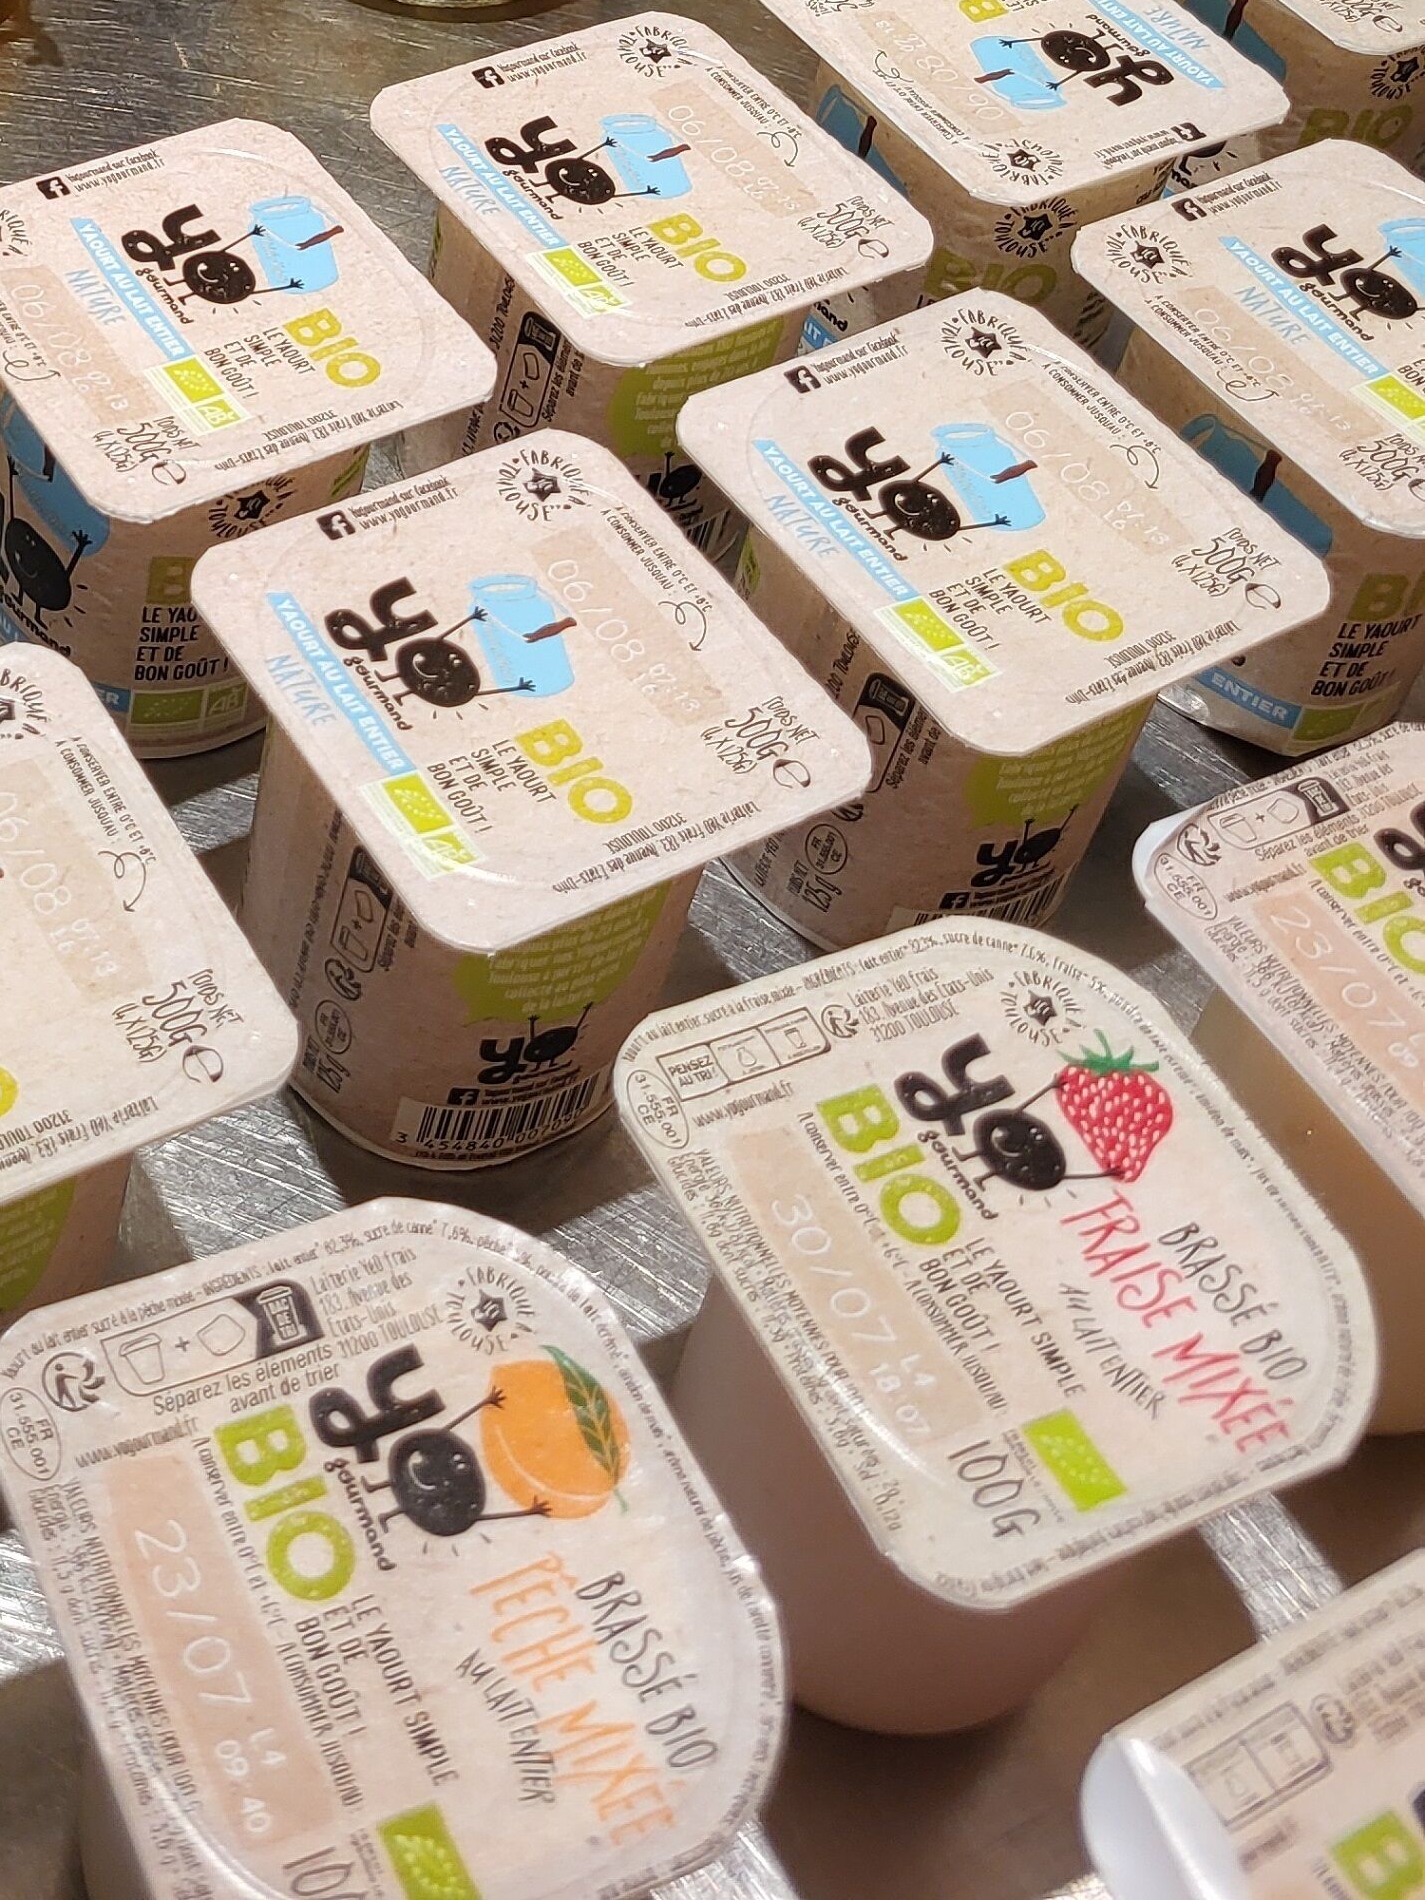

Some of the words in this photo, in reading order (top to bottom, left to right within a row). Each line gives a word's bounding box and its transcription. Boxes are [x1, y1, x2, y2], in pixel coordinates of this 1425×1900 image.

[644, 213, 743, 285] BIO
[134, 266, 195, 325] gourmand
[1298, 281, 1375, 342] gourmand
[281, 307, 380, 390] BIO
[760, 447, 816, 499] YAOURT
[807, 499, 835, 519] AU
[826, 518, 863, 549] LAIT
[854, 548, 908, 598] ENTIER
[831, 494, 909, 562] gourmand
[1002, 547, 1122, 643] BIO
[139, 625, 200, 642] SIMPLE
[1329, 641, 1389, 658] SIMPLE
[135, 665, 168, 680] BON
[273, 600, 327, 659] YAOURT
[314, 659, 343, 682] AU
[331, 681, 368, 716] LAIT
[356, 715, 407, 771] ENTIER
[342, 654, 415, 731] gourmand
[1211, 672, 1289, 720] ENTIER
[515, 715, 633, 823] BIO
[663, 1054, 715, 1078] PENSEZ
[814, 1081, 960, 1246] BIO
[916, 1130, 998, 1222] gourmand
[918, 1257, 958, 1296] BON
[964, 1237, 995, 1261] LE
[981, 1258, 1043, 1331] YAOURT
[1027, 1330, 1086, 1399] SIMPLE
[1059, 1192, 1199, 1330] FRAISE
[1149, 1332, 1291, 1459] MIXÉE
[149, 1380, 215, 1419] Séparez
[213, 1373, 238, 1395] les
[236, 1343, 336, 1386] éléments
[226, 1388, 267, 1415] avant
[266, 1378, 294, 1400] de
[292, 1361, 342, 1390] trier
[212, 1402, 352, 1598] BIO
[323, 1456, 396, 1573] gourmand
[293, 1616, 335, 1664] BON
[351, 1595, 381, 1626] LE
[365, 1625, 419, 1707] YAOURT
[404, 1709, 458, 1788] SIMPLE
